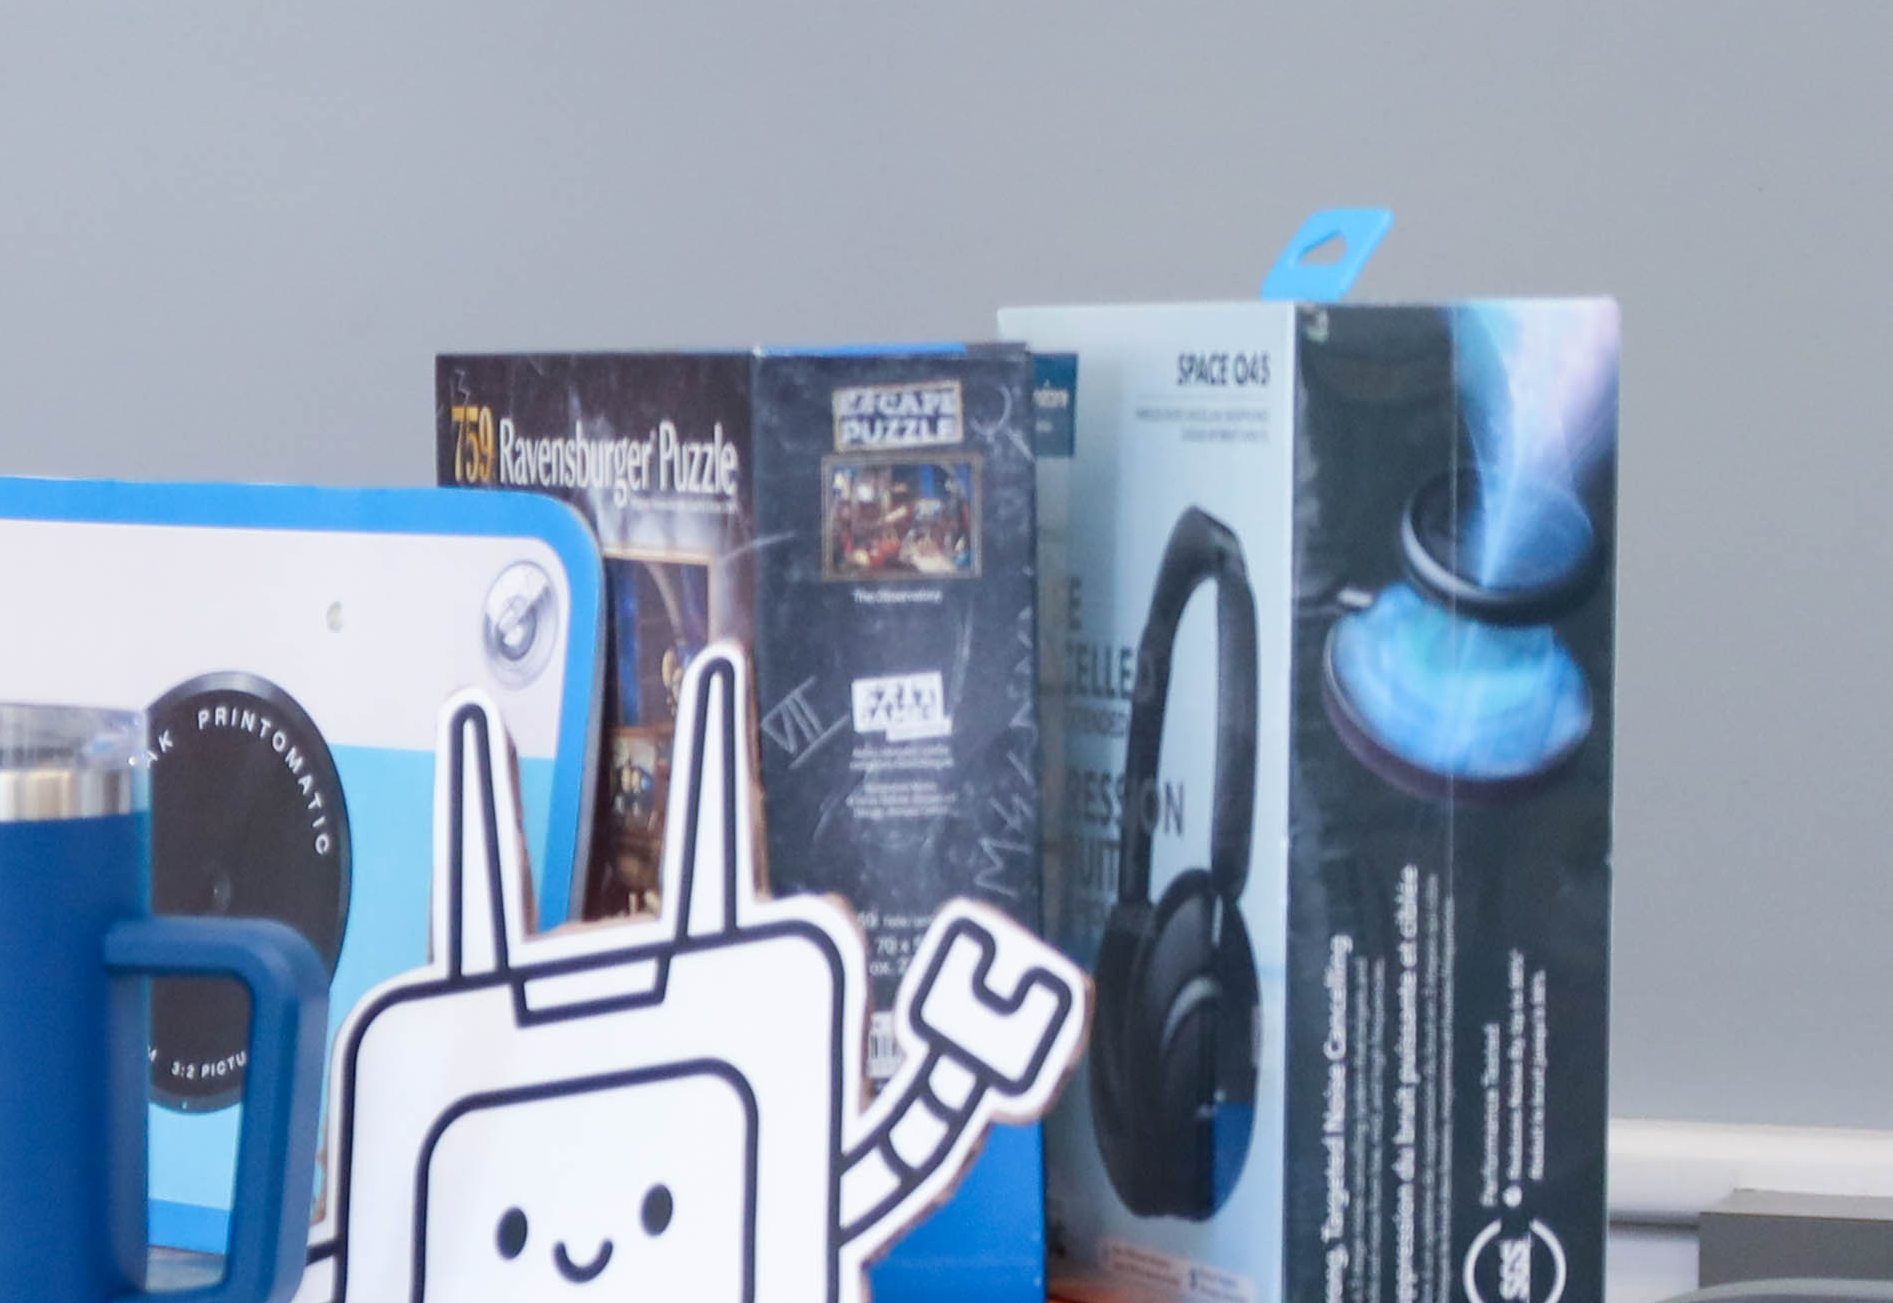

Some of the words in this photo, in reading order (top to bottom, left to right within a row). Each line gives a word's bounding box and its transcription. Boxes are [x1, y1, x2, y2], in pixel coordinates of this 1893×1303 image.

[1176, 352, 1229, 387] SPACE
[451, 405, 496, 484] 759
[499, 417, 653, 508] Ravensburger
[658, 418, 738, 495] Puzzle
[841, 416, 956, 446] PUZZLE
[196, 705, 330, 857] PRINTOMATIC
[1323, 933, 1353, 1060] Cancelling
[170, 1060, 196, 1079] 3:2
[200, 1050, 247, 1079] PICTU
[1323, 1060, 1347, 1134] Noise
[1321, 1135, 1349, 1242] Targeted
